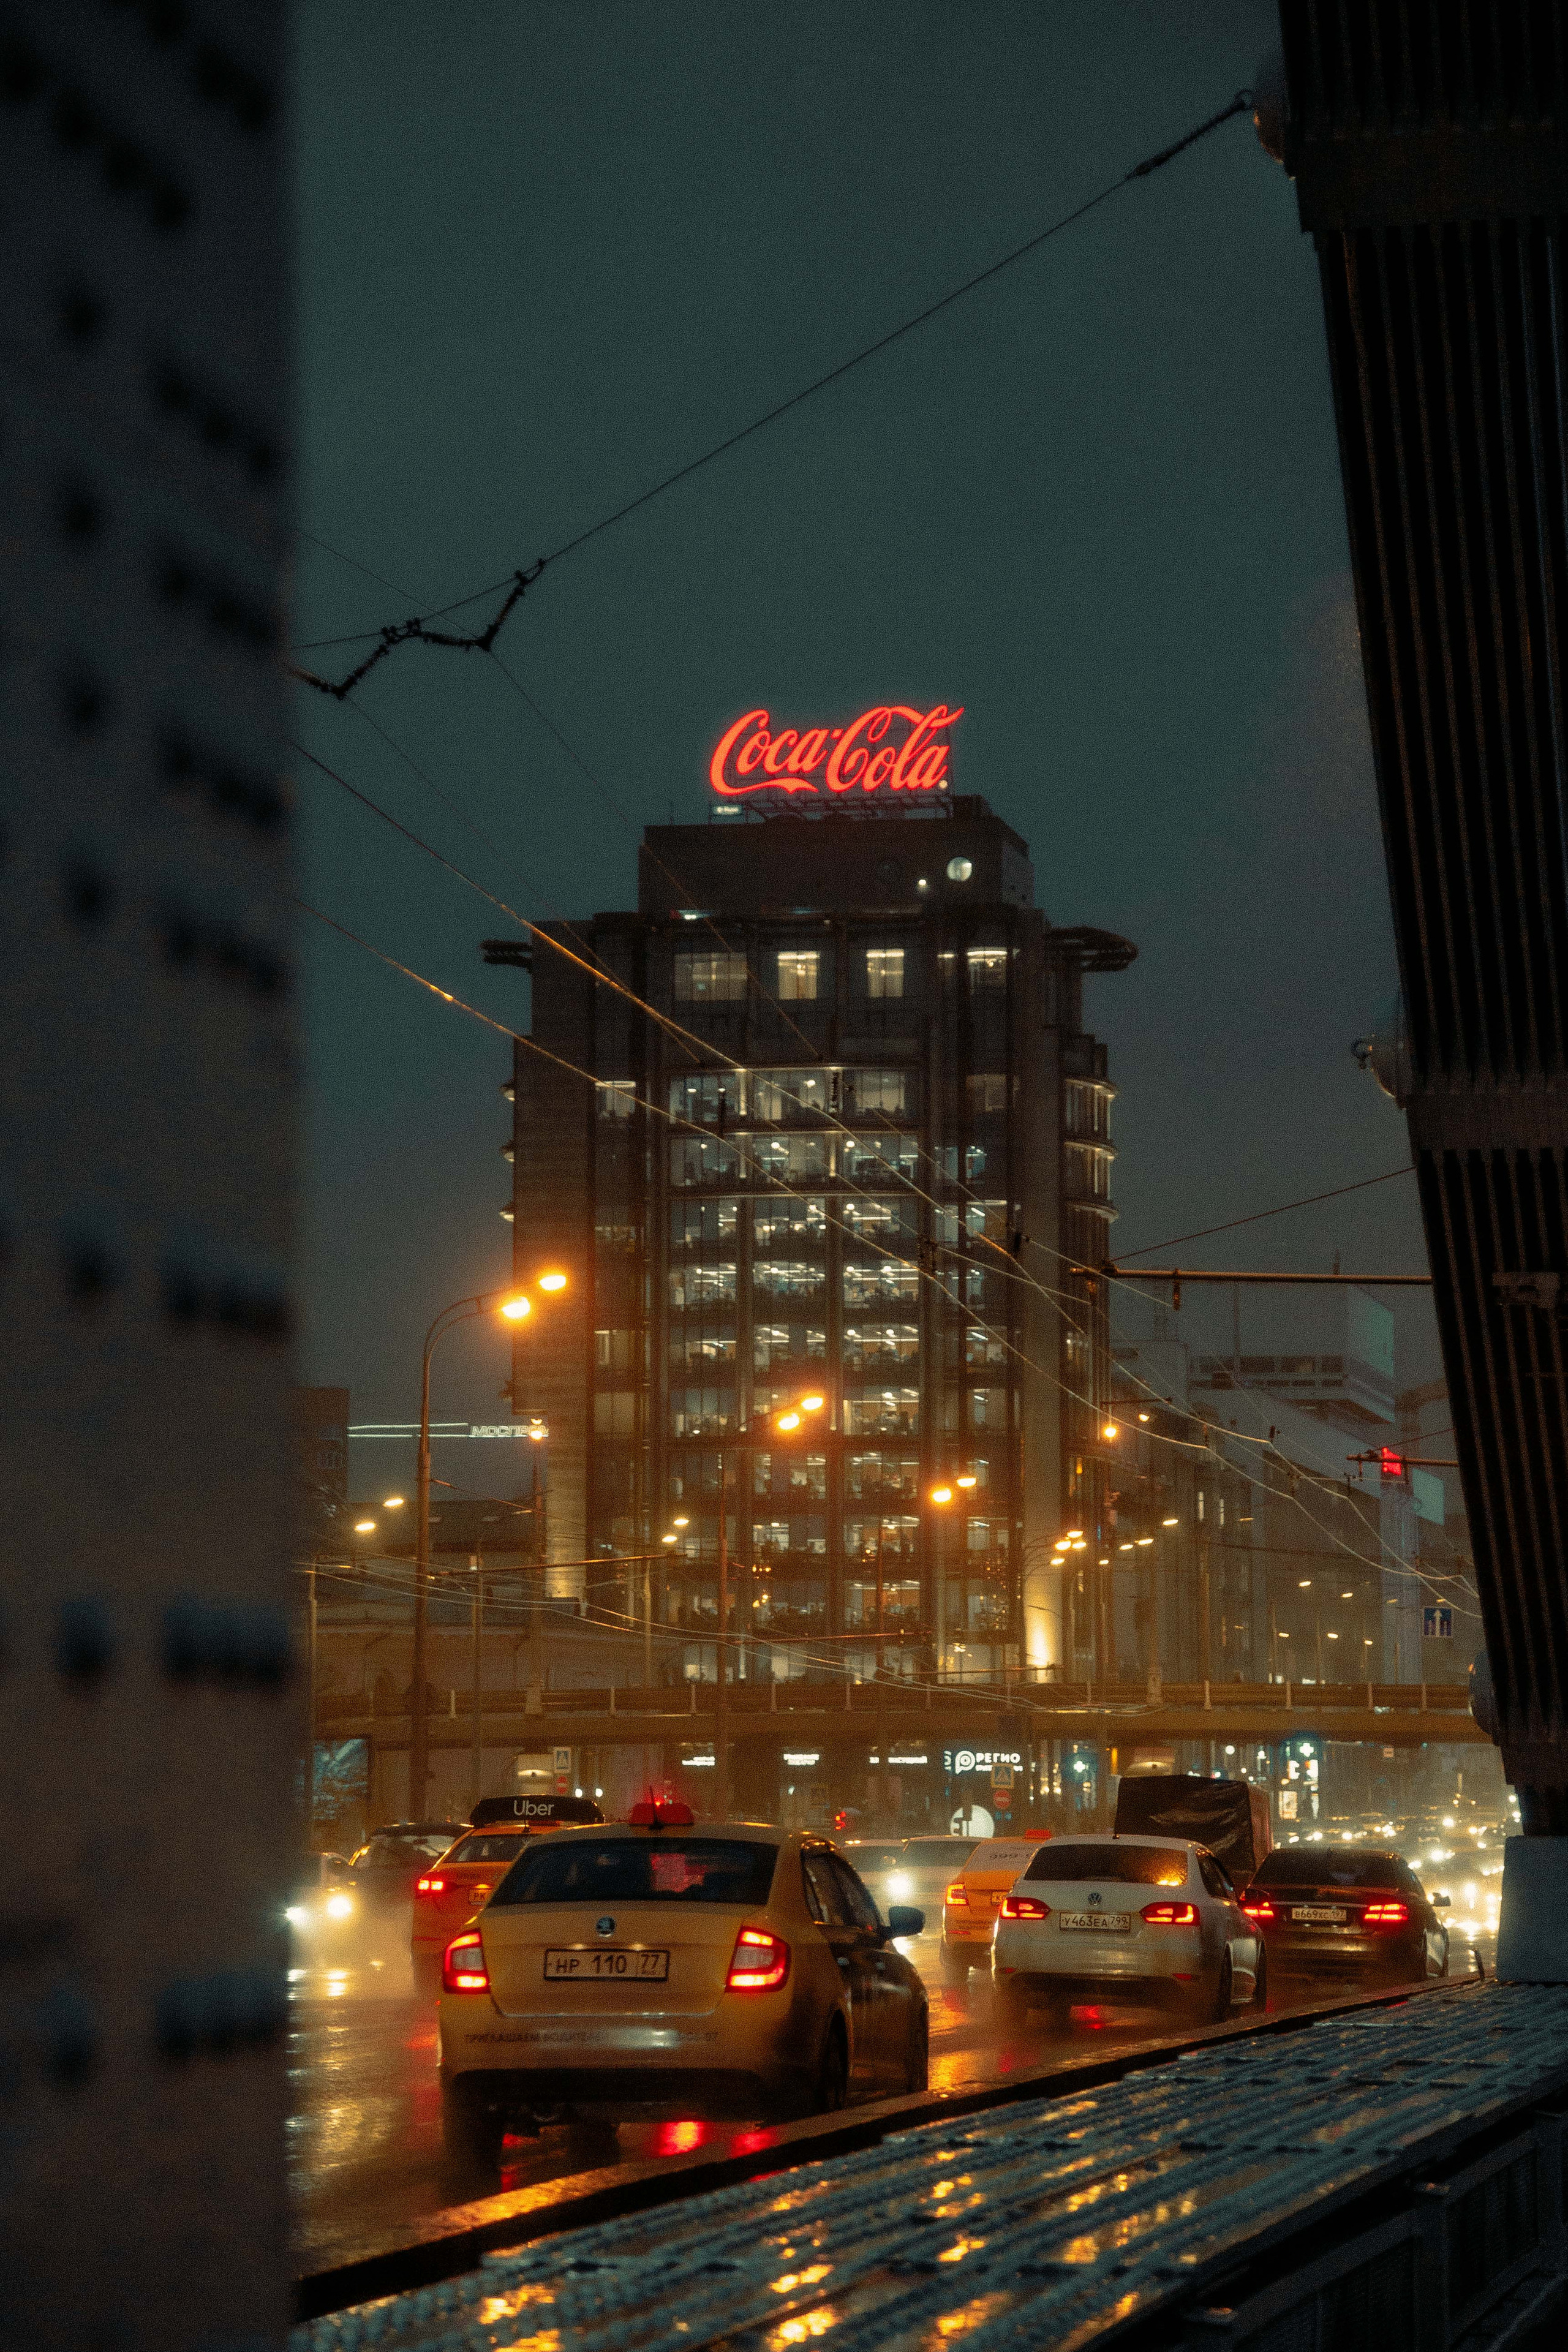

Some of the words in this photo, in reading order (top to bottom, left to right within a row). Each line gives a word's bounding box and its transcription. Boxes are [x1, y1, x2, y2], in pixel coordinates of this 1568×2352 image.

[710, 704, 965, 795] Coca-Cola
[976, 1752, 1021, 1763] РЕГИО
[513, 1800, 555, 1816] Uber
[592, 1954, 627, 1974] 110
[641, 1953, 660, 1970] 77
